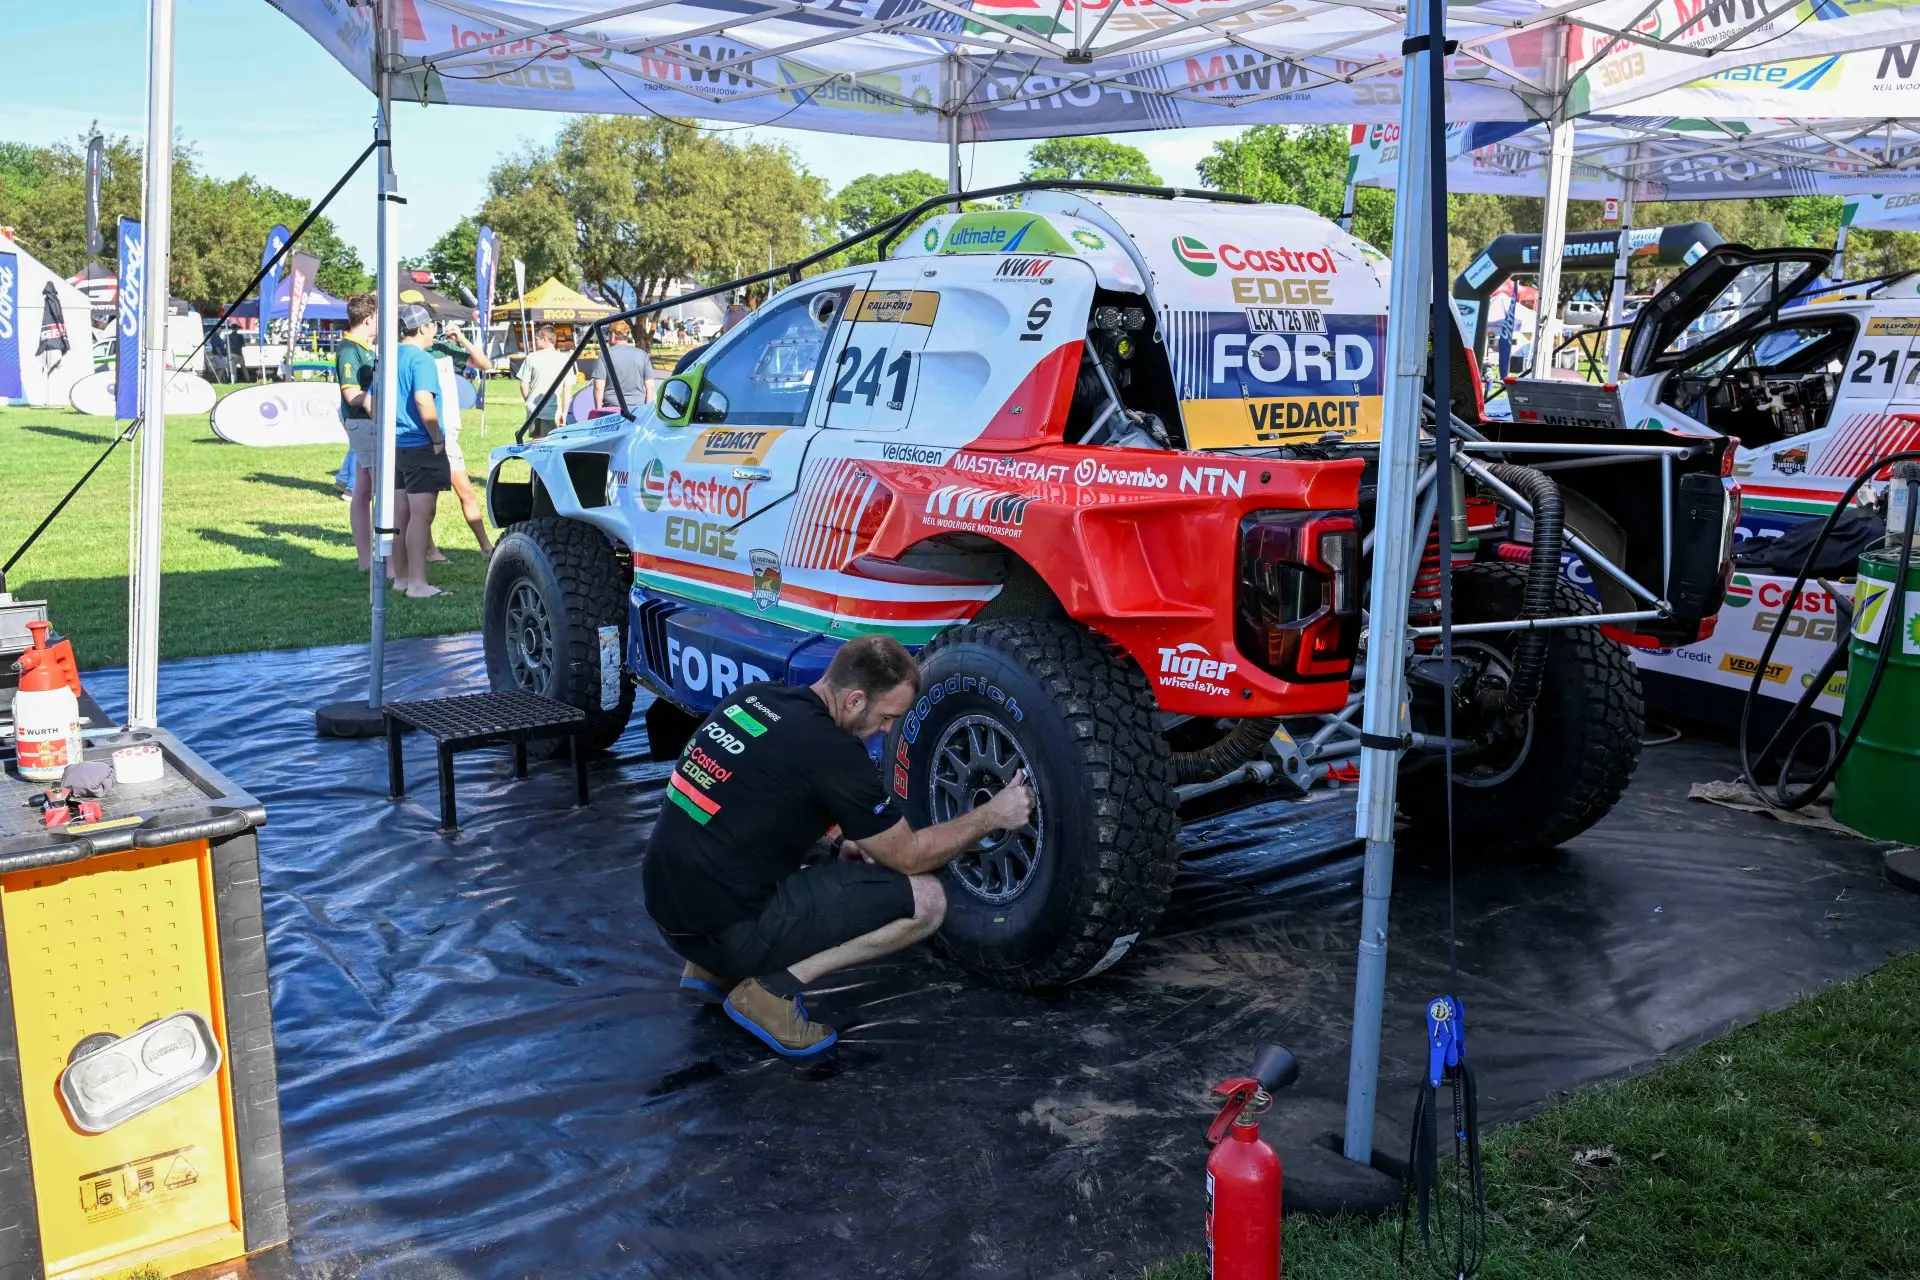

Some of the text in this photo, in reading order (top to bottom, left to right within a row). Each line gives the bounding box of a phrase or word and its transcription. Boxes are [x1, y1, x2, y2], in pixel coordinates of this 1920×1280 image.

[1873, 83, 1893, 92] NEIL
[1884, 194, 1920, 210] EDG
[950, 226, 1006, 246] ultimate
[1564, 242, 1614, 257] RTHAM
[996, 258, 1053, 277] NWM
[1218, 243, 1338, 274] Castrol
[118, 234, 142, 336] Ford
[1231, 277, 1335, 305] EDGE
[543, 309, 576, 320] INGCO
[867, 301, 912, 311] RALLY-RAID
[1250, 309, 1321, 332] LCK 726 MP
[1212, 333, 1374, 384] FORD
[1850, 349, 1920, 385] 217
[826, 346, 912, 411] 241
[1249, 401, 1360, 431] VEDACIT
[705, 430, 767, 450] VEDACIT
[882, 444, 943, 466] Veldskoen
[953, 453, 1069, 484] MASTERCRAFT
[1097, 464, 1168, 489] brembo
[1179, 466, 1247, 498] NTN
[667, 470, 753, 520] Castrol
[925, 484, 1044, 526] NWM
[664, 515, 740, 561] EDGE
[922, 515, 1022, 538] NEIL WOOLRIDGE MOTORSPORT
[1752, 611, 1838, 643] EDG
[1158, 646, 1238, 682] Tiger
[1676, 648, 1712, 664] Credit
[752, 701, 782, 722] SAPPHIRE
[26, 727, 59, 736] WÜRTH
[702, 721, 745, 755] FORD
[681, 759, 717, 790] EDGE
[691, 746, 733, 783] Castrol
